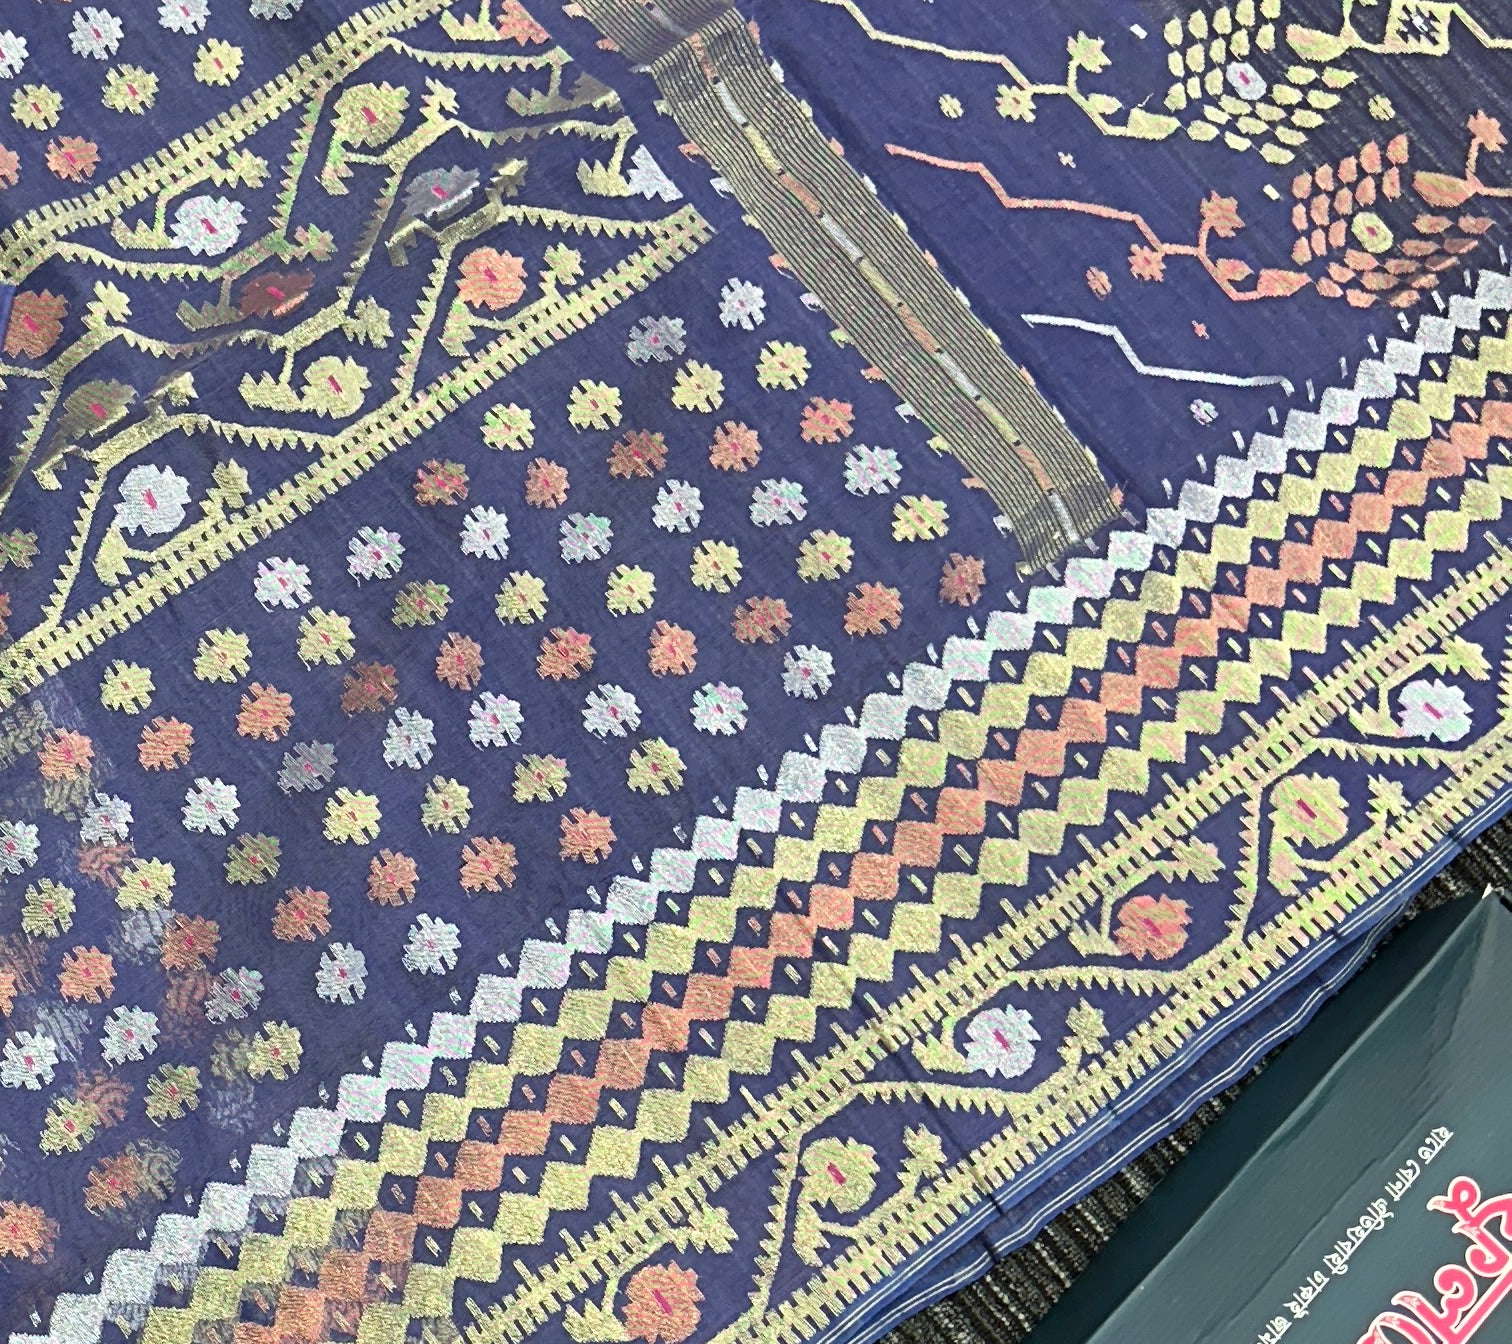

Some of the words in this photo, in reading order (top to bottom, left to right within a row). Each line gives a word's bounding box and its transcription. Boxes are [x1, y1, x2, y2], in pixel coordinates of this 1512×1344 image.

[1417, 1126, 1454, 1165] হাতে
[1384, 1159, 1421, 1201] বোনা
[1322, 1198, 1394, 1275] ঐতিহ্যবাহী
[1283, 1270, 1330, 1319] ঢাকাই
